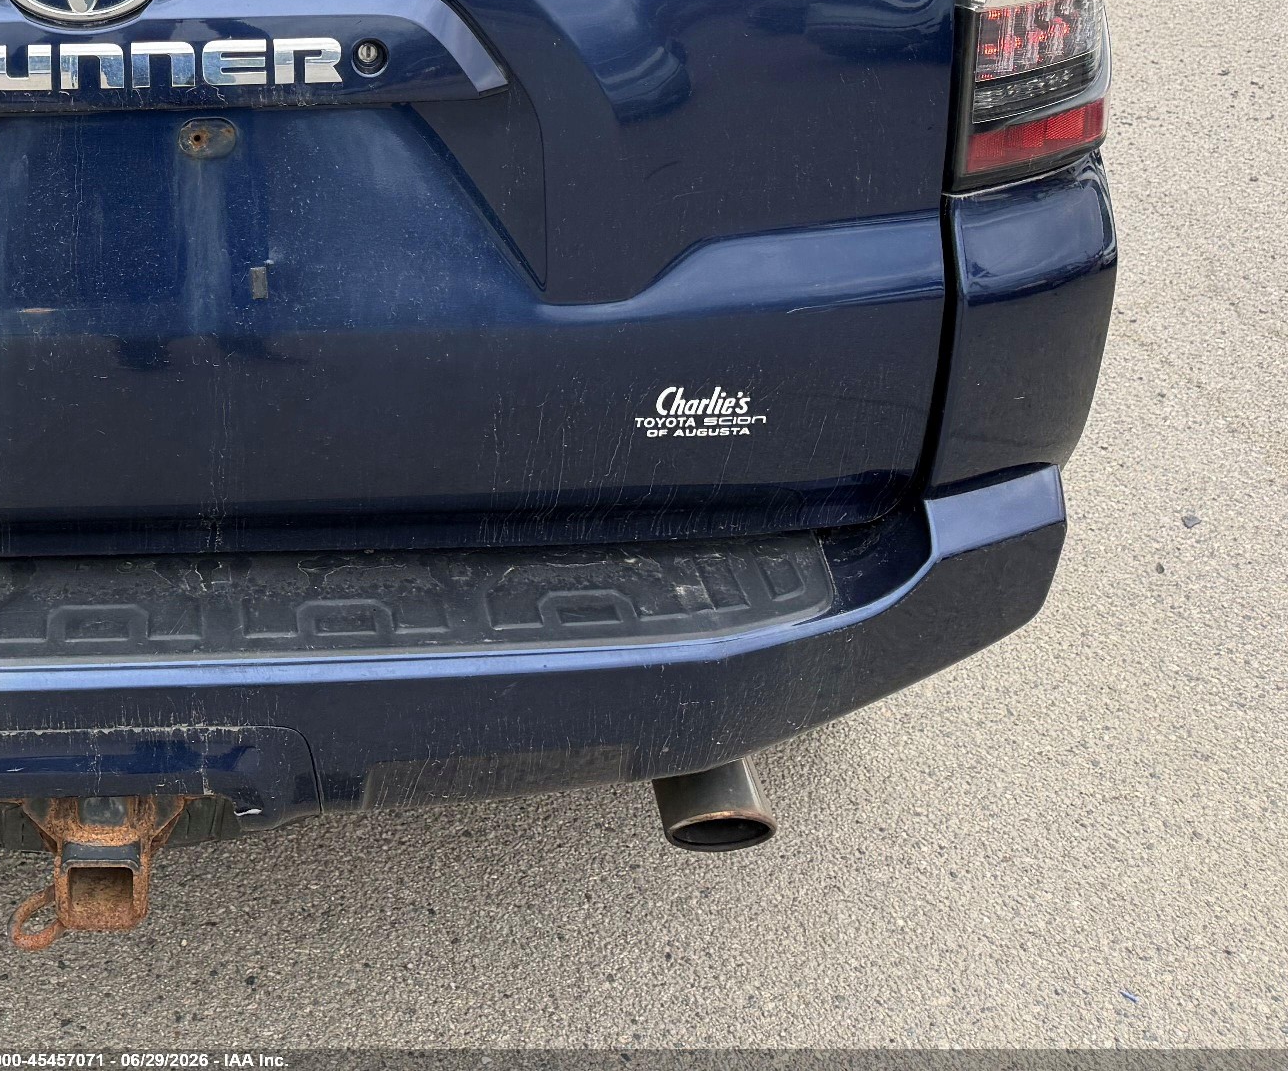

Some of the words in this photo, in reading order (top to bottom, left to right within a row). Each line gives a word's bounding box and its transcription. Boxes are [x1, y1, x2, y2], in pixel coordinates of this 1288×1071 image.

[655, 387, 750, 416] Charlie's
[635, 417, 696, 428] TOYOTA
[646, 429, 668, 438] OF
[673, 428, 750, 437] AUGUSTA
